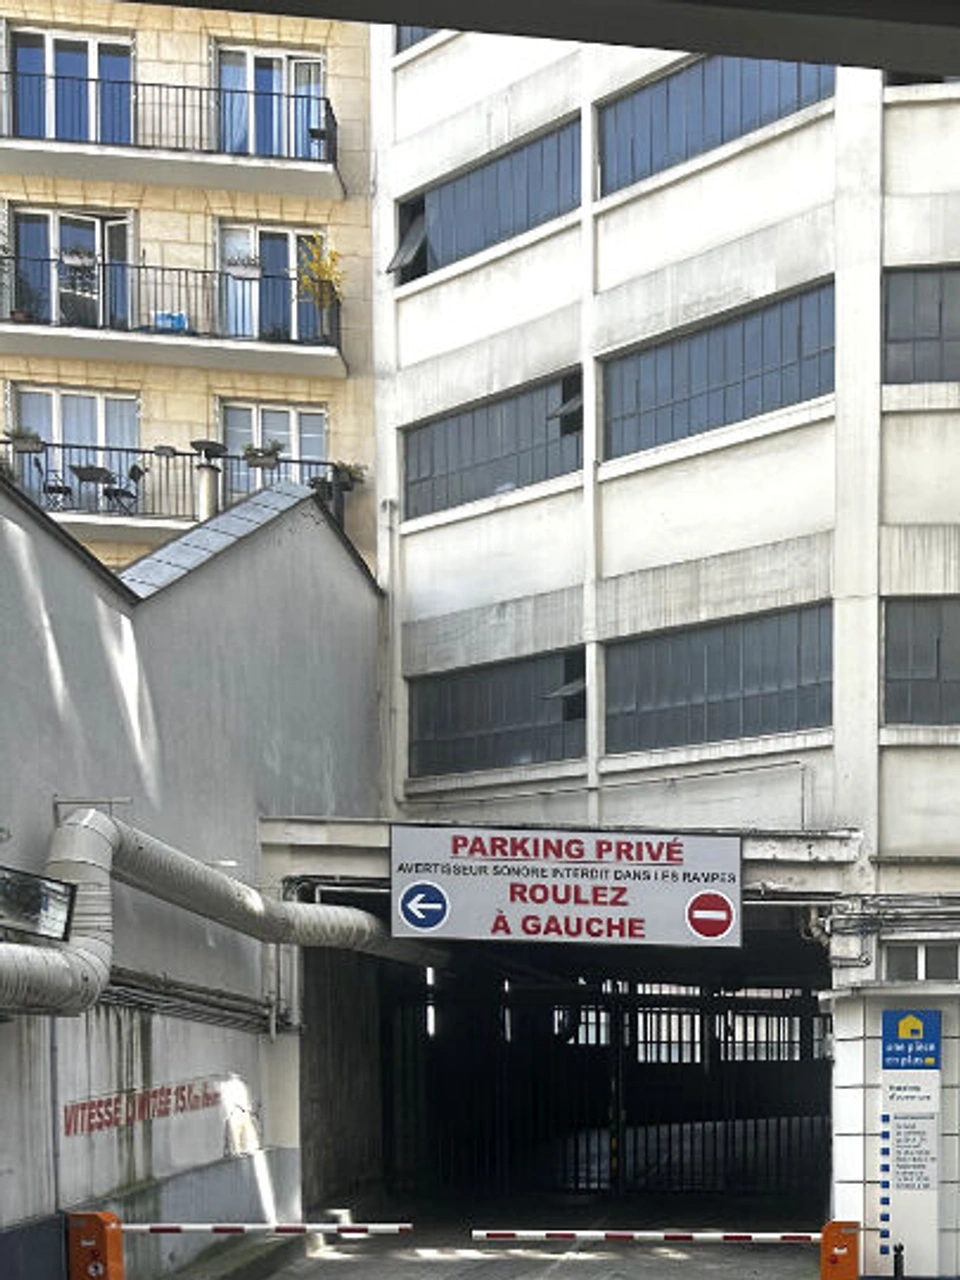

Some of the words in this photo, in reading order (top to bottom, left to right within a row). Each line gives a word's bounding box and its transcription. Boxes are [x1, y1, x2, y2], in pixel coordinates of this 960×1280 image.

[451, 834, 585, 859] PARKING
[595, 837, 684, 862] PRIVÉ
[396, 862, 489, 876] AVERTISSEUR
[493, 864, 549, 879] SONORE
[551, 867, 610, 880] INTERDIT
[613, 869, 651, 881] DANS
[654, 870, 679, 883] LES
[682, 871, 737, 884] RAMPES
[509, 882, 629, 906] ROULEZ
[490, 908, 511, 935] À
[521, 914, 646, 938] GAUCHE
[63, 1096, 120, 1137] VITESSE
